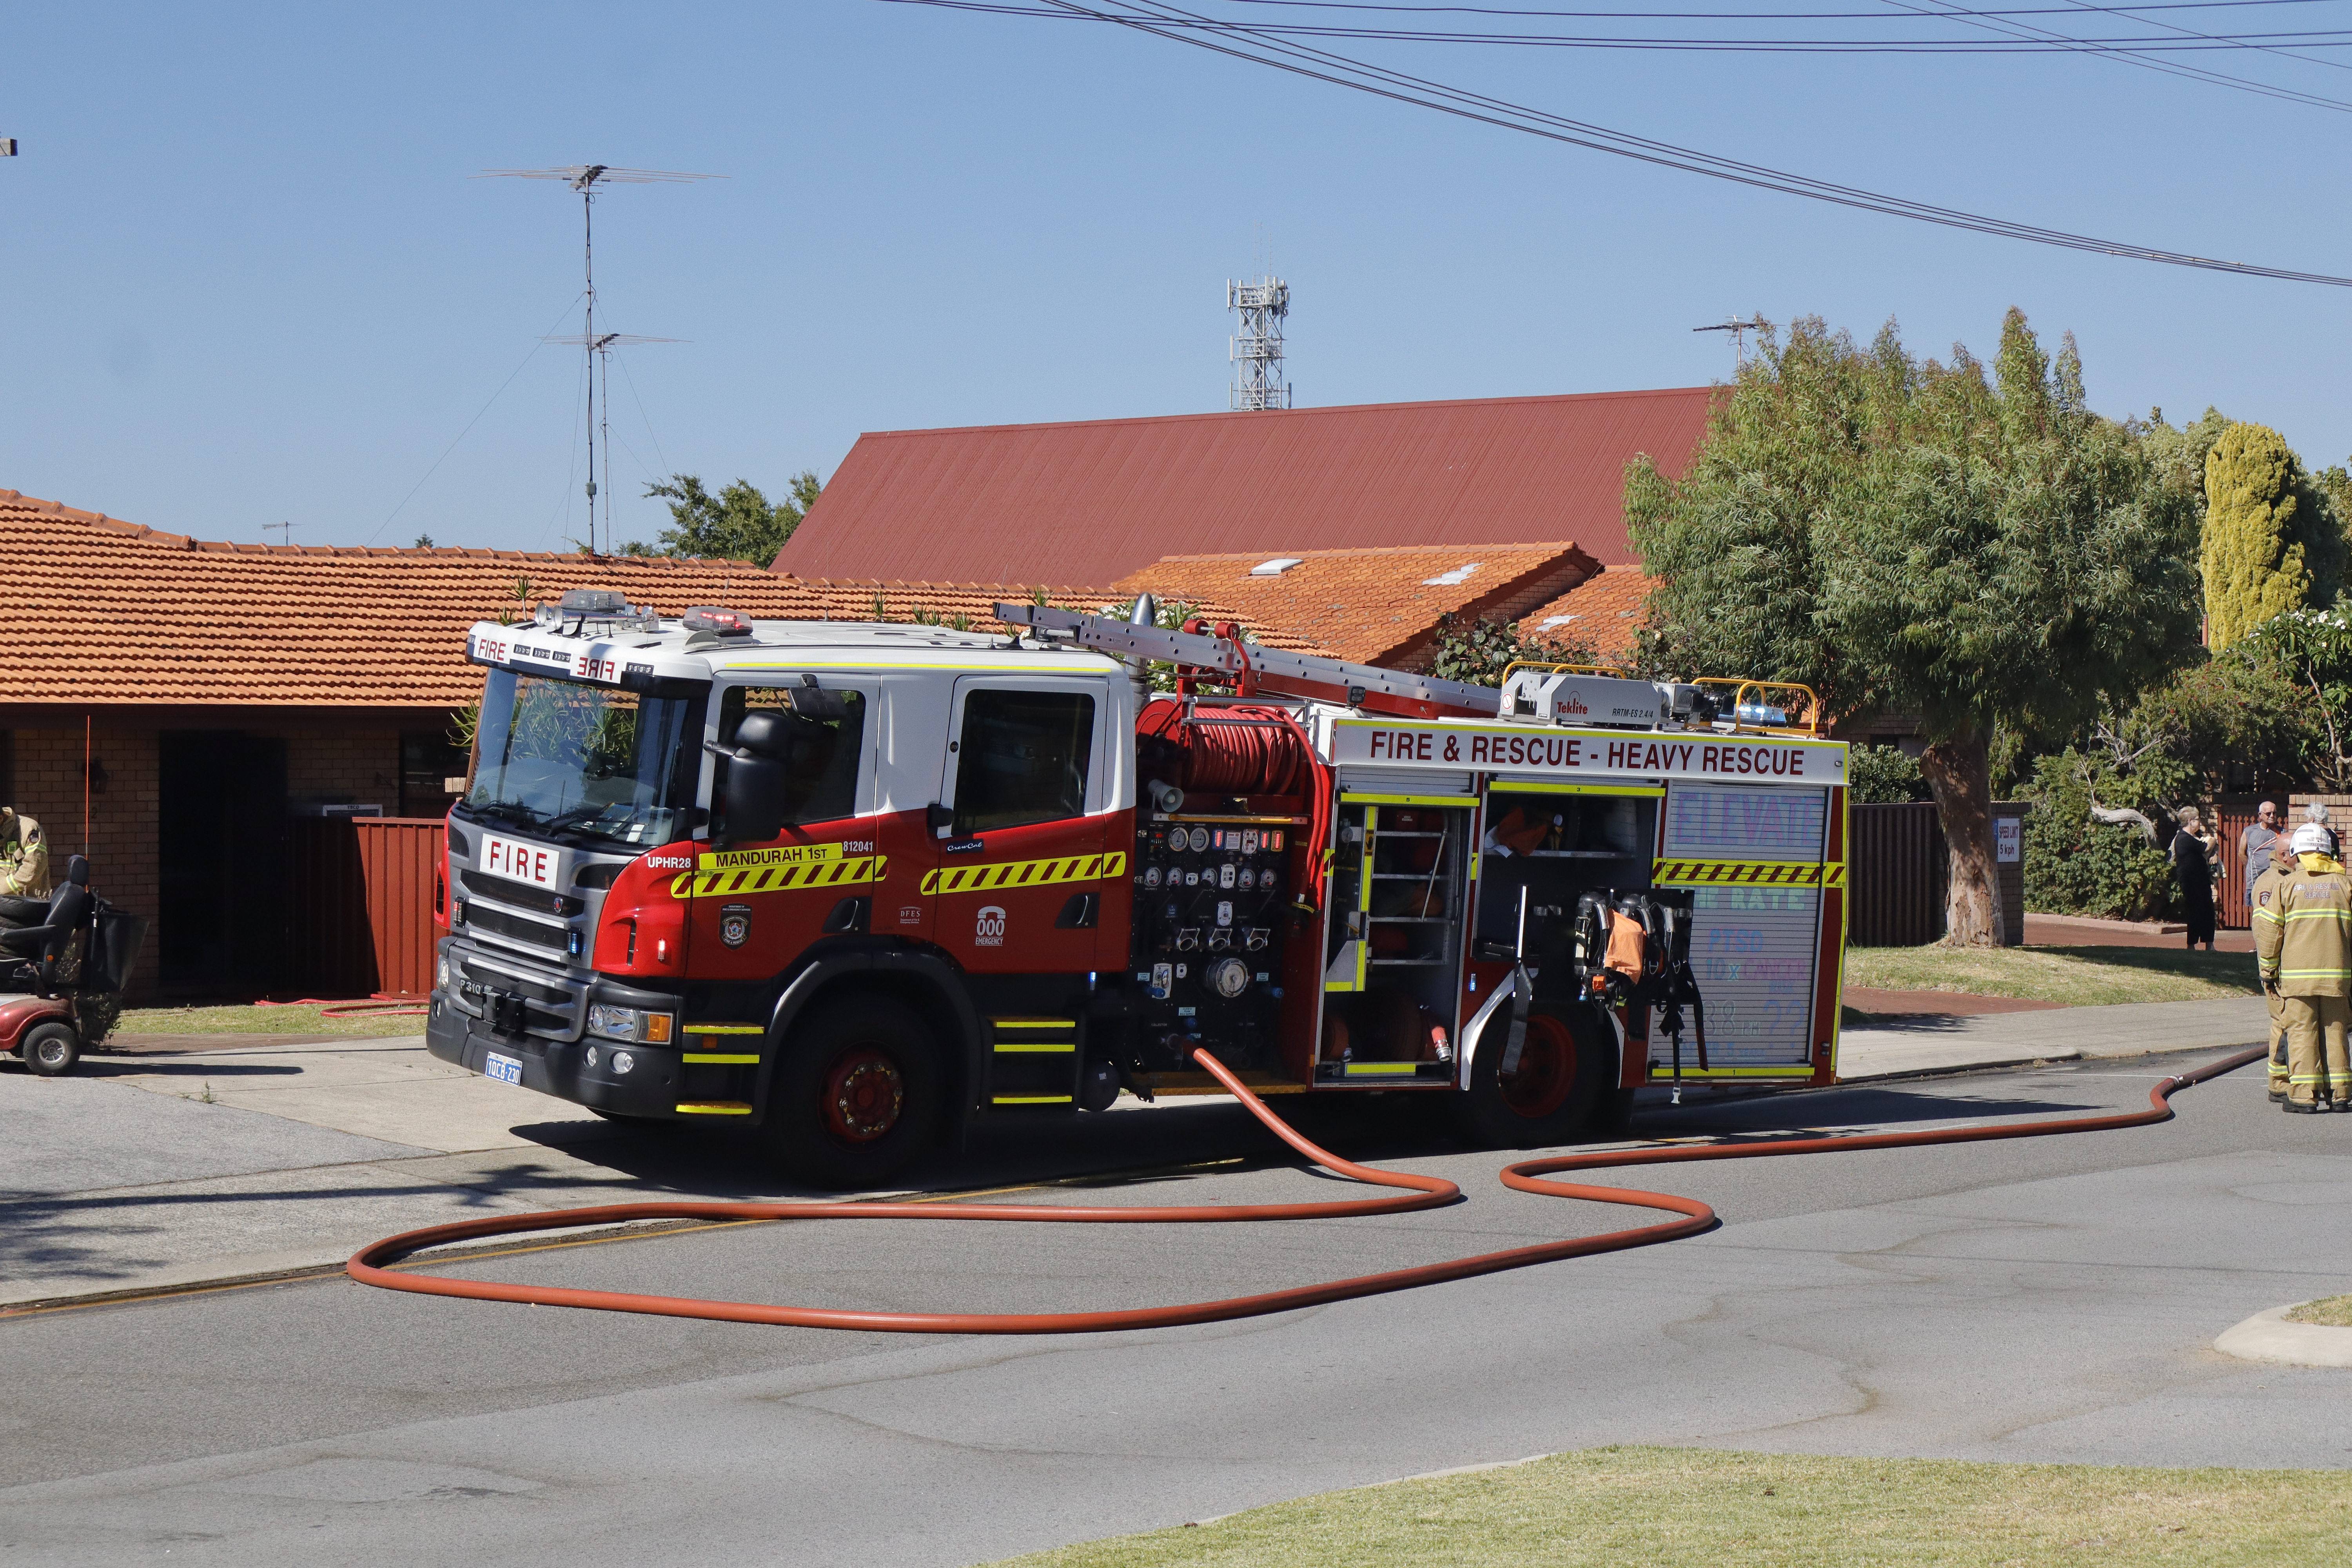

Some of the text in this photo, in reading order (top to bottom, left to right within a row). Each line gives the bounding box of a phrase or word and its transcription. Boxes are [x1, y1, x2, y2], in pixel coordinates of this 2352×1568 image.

[478, 639, 506, 662] FIRE
[1557, 698, 1588, 715] Teklite
[1612, 708, 1653, 719] RRTM-ES 2.4/4
[1370, 731, 1433, 760] FIRE
[1443, 735, 1460, 762] &
[1472, 735, 1581, 766] RESCUE
[1608, 742, 1694, 771] HEAVY
[1703, 746, 1804, 776] RESCUE
[1676, 792, 1822, 847] ELEVATE
[843, 841, 873, 852] 812041
[2000, 844, 2014, 857] 5 kph
[490, 841, 548, 882] FIRE
[648, 857, 691, 868] UPHR28
[716, 848, 828, 868] MANDURAH 1ST
[1731, 887, 1806, 910] RATE
[976, 918, 1005, 936] 000
[975, 937, 1004, 945] EMERGENCY
[1708, 928, 1764, 953] PTSD
[466, 981, 481, 995] 310
